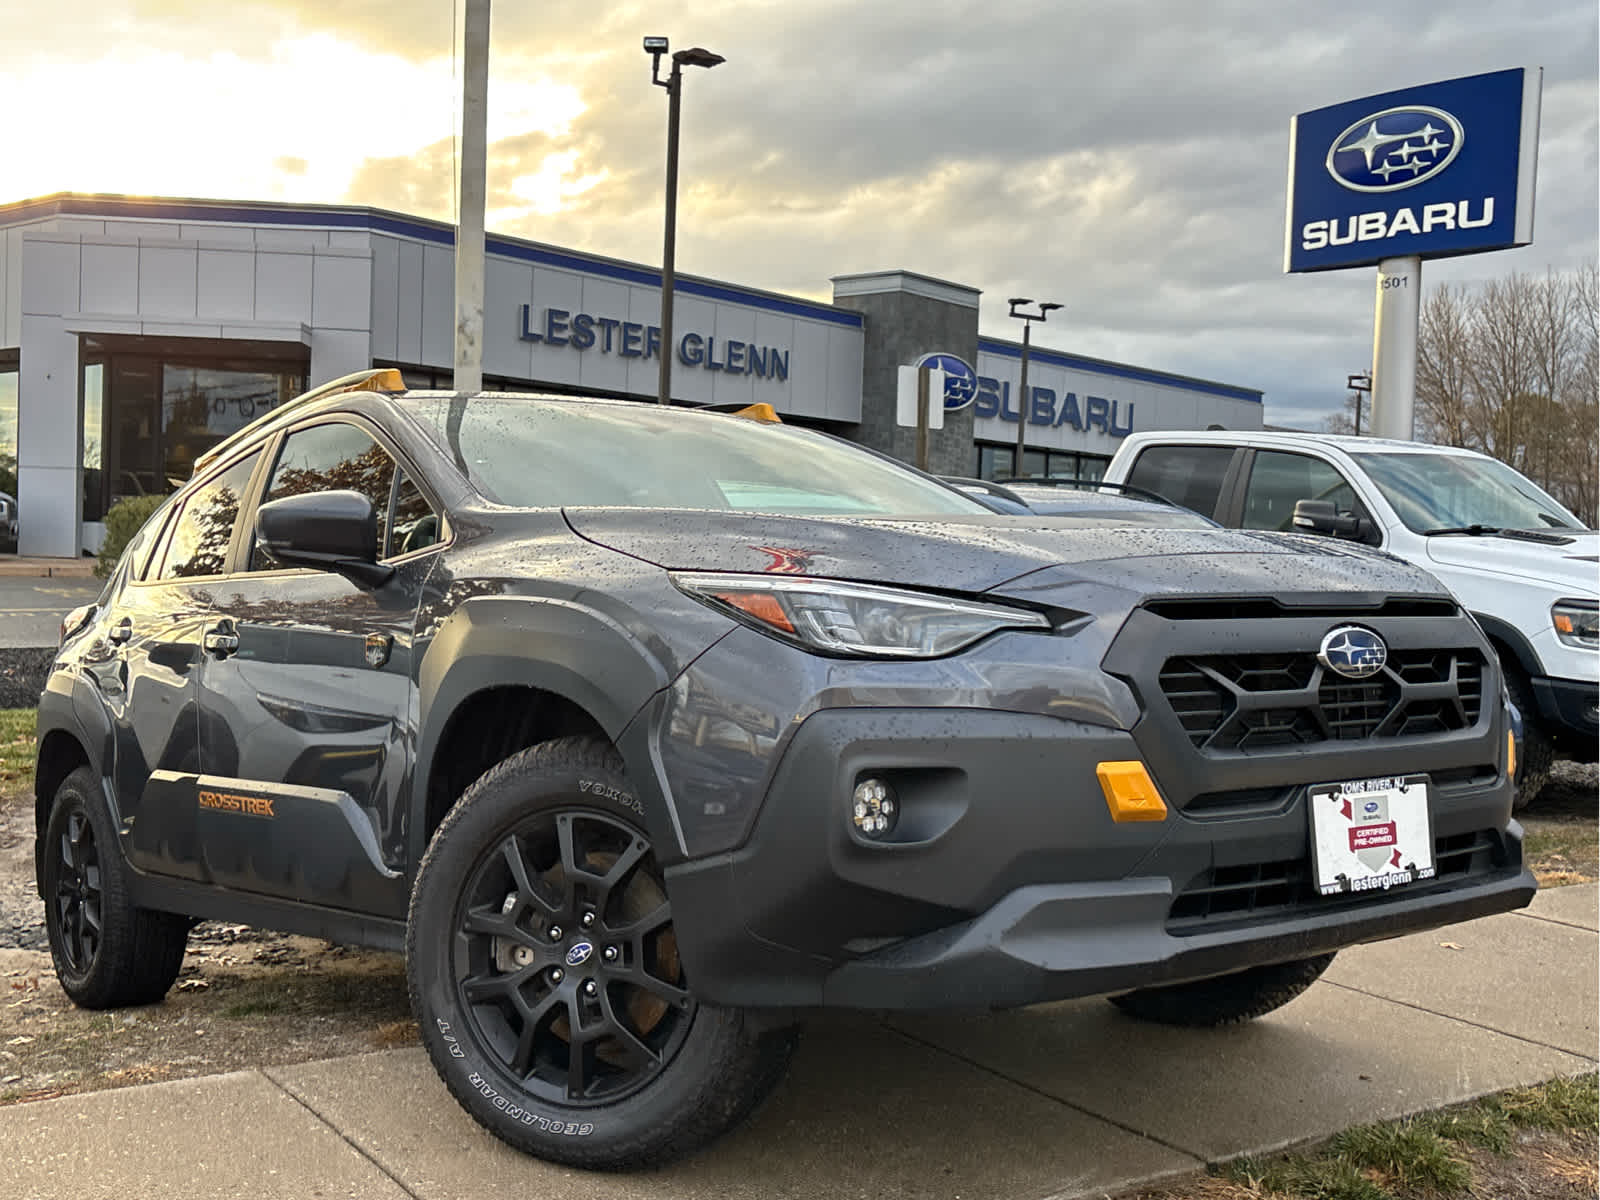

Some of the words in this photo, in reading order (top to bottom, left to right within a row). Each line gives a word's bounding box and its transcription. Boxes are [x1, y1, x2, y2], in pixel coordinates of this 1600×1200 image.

[1302, 197, 1494, 250] SUBARU
[680, 332, 789, 381] GLENN
[974, 376, 1134, 437] SUBARU
[199, 791, 274, 816] CROSSTREK
[1341, 782, 1365, 794] TOMS
[1394, 776, 1405, 789] NJ
[1353, 834, 1393, 847] PRE-OWNED
[1356, 827, 1389, 838] CERTIFIED
[437, 1017, 465, 1058] A/T
[468, 1072, 594, 1136] GEOLANDAR
